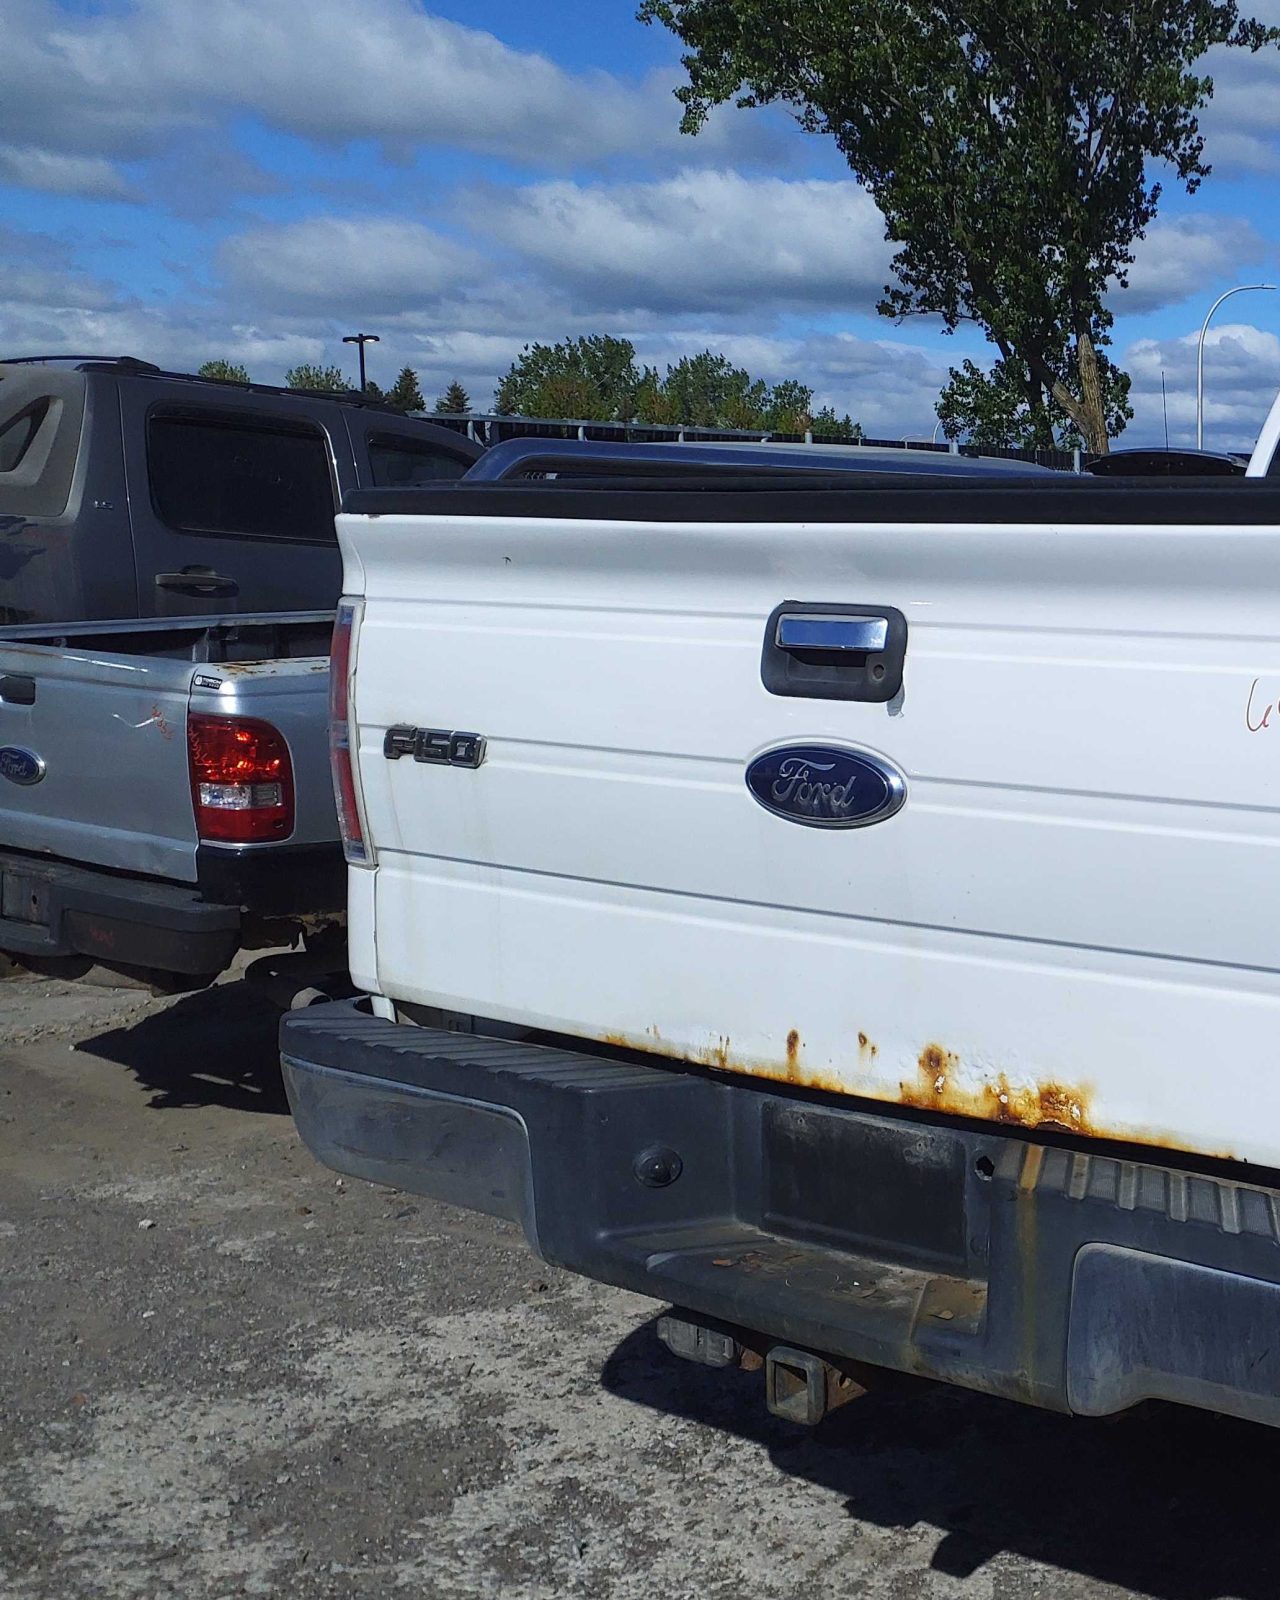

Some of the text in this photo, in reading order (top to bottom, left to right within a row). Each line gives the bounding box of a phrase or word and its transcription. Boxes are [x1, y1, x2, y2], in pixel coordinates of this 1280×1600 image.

[2, 752, 27, 776] Ford
[383, 724, 488, 770] F150
[771, 757, 857, 809] Ford
